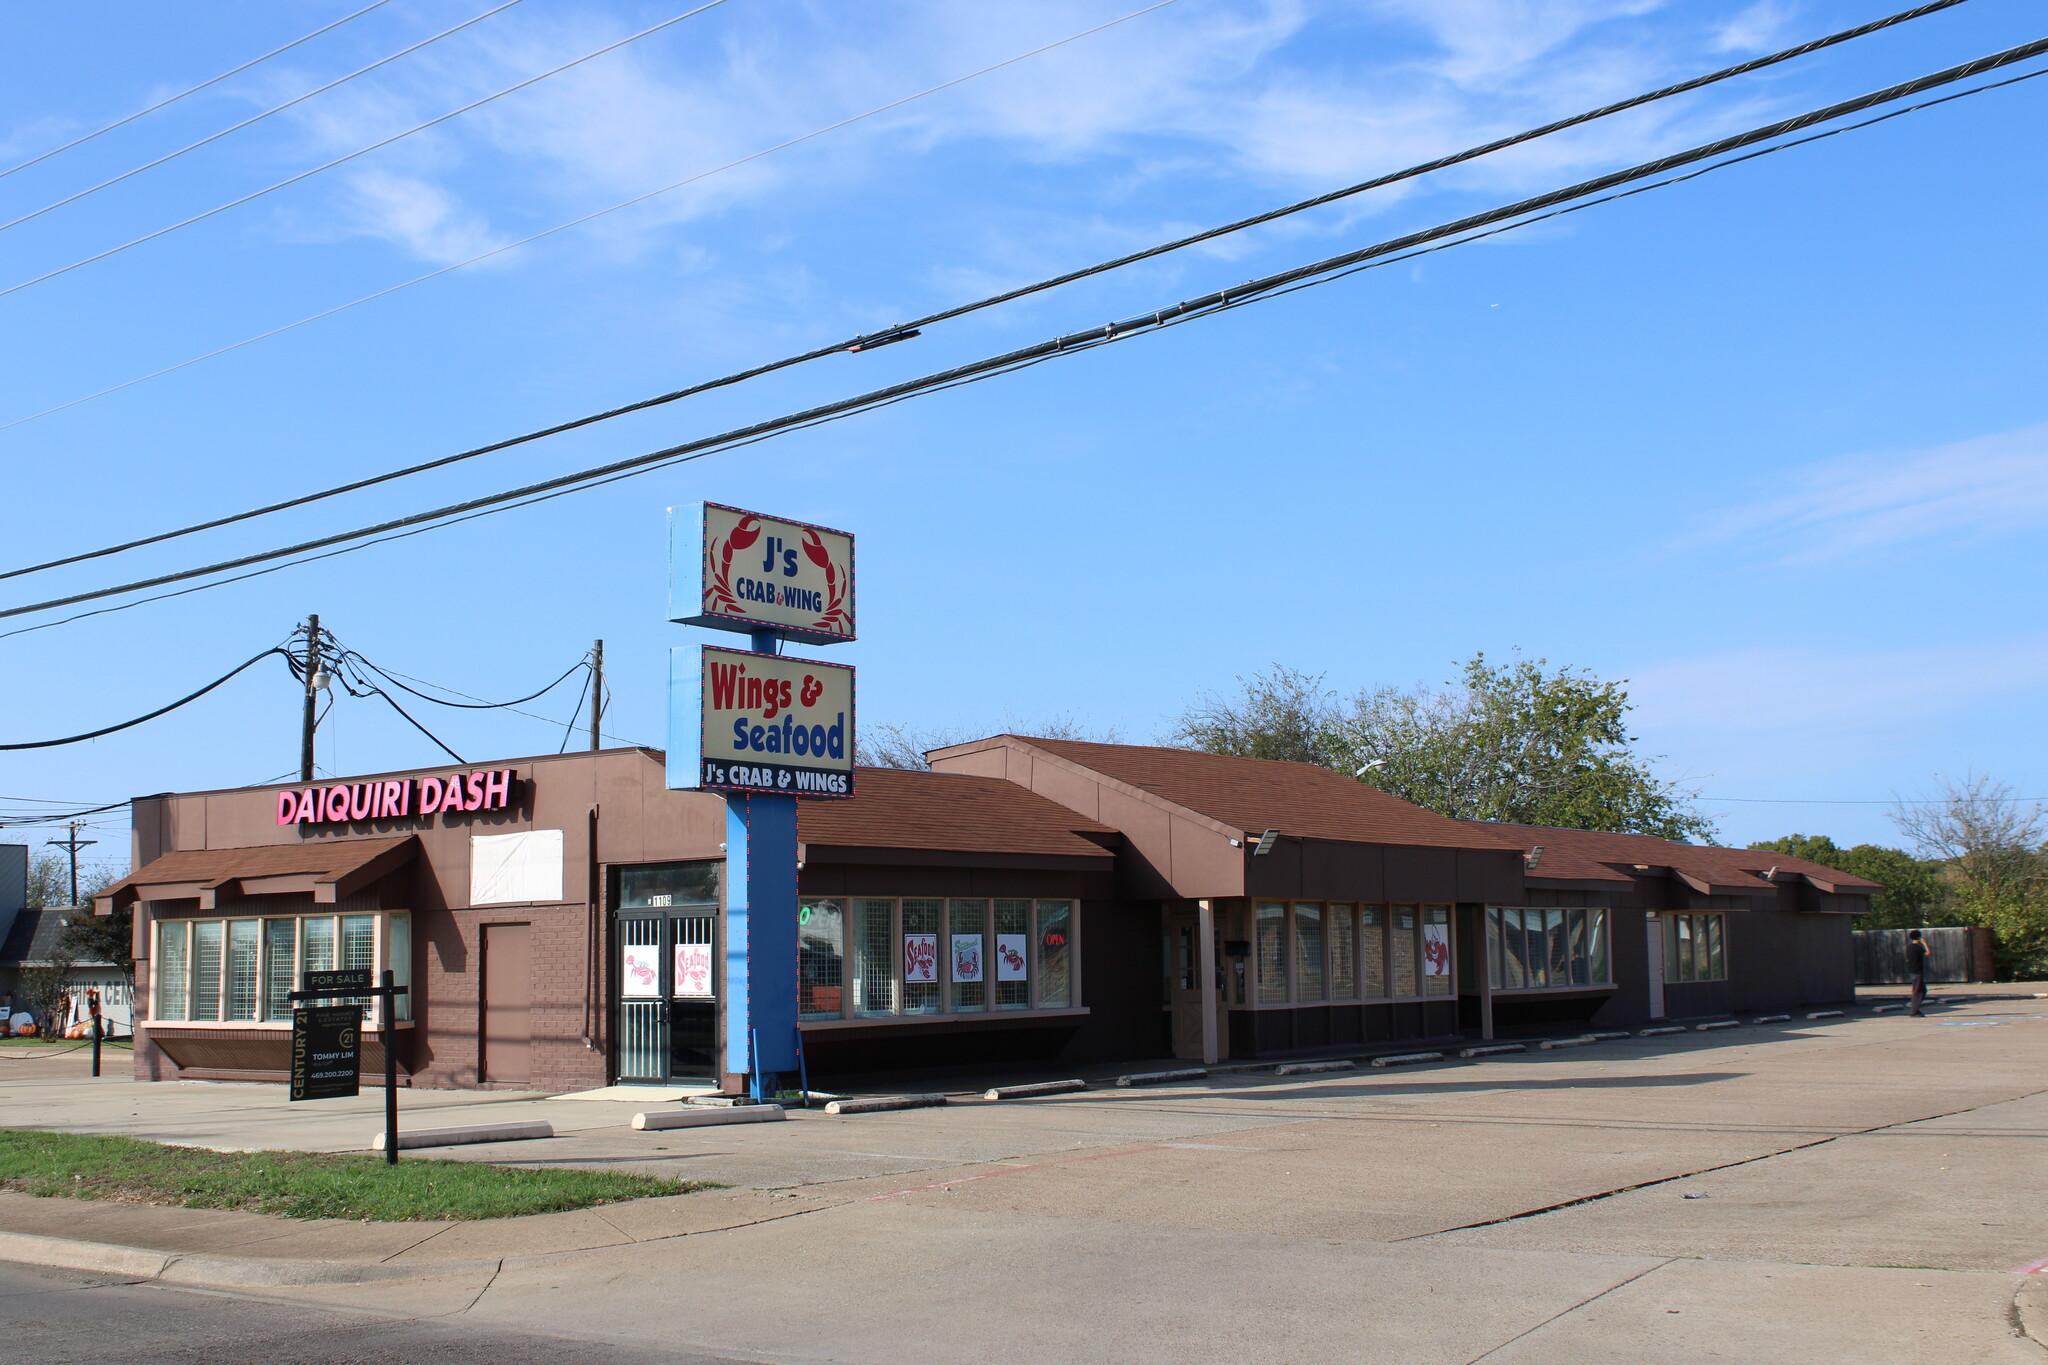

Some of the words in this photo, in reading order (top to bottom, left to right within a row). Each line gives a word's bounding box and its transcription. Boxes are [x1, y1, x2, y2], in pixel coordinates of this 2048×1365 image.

[763, 536, 798, 577] J's
[736, 577, 775, 605] CRAB
[776, 591, 785, 606] &
[784, 585, 822, 613] WING
[710, 662, 792, 719] Wings
[800, 675, 823, 708] &
[733, 712, 844, 760] Seafood
[706, 763, 725, 783] J's
[729, 765, 773, 788] CRAB
[777, 769, 791, 789] &
[795, 771, 847, 793] WINGS
[276, 779, 412, 826] DAIQUIRI
[419, 769, 512, 815] DASH
[654, 895, 671, 906] 1109
[1046, 934, 1065, 946] OPEN
[311, 976, 333, 985] FOR
[336, 974, 364, 984] SALE
[296, 1011, 308, 1025] 21
[293, 1029, 307, 1099] CENTURY
[312, 1053, 340, 1061] TOMMY
[341, 1051, 354, 1059] LIM
[311, 1070, 354, 1079] 469.200.2200
